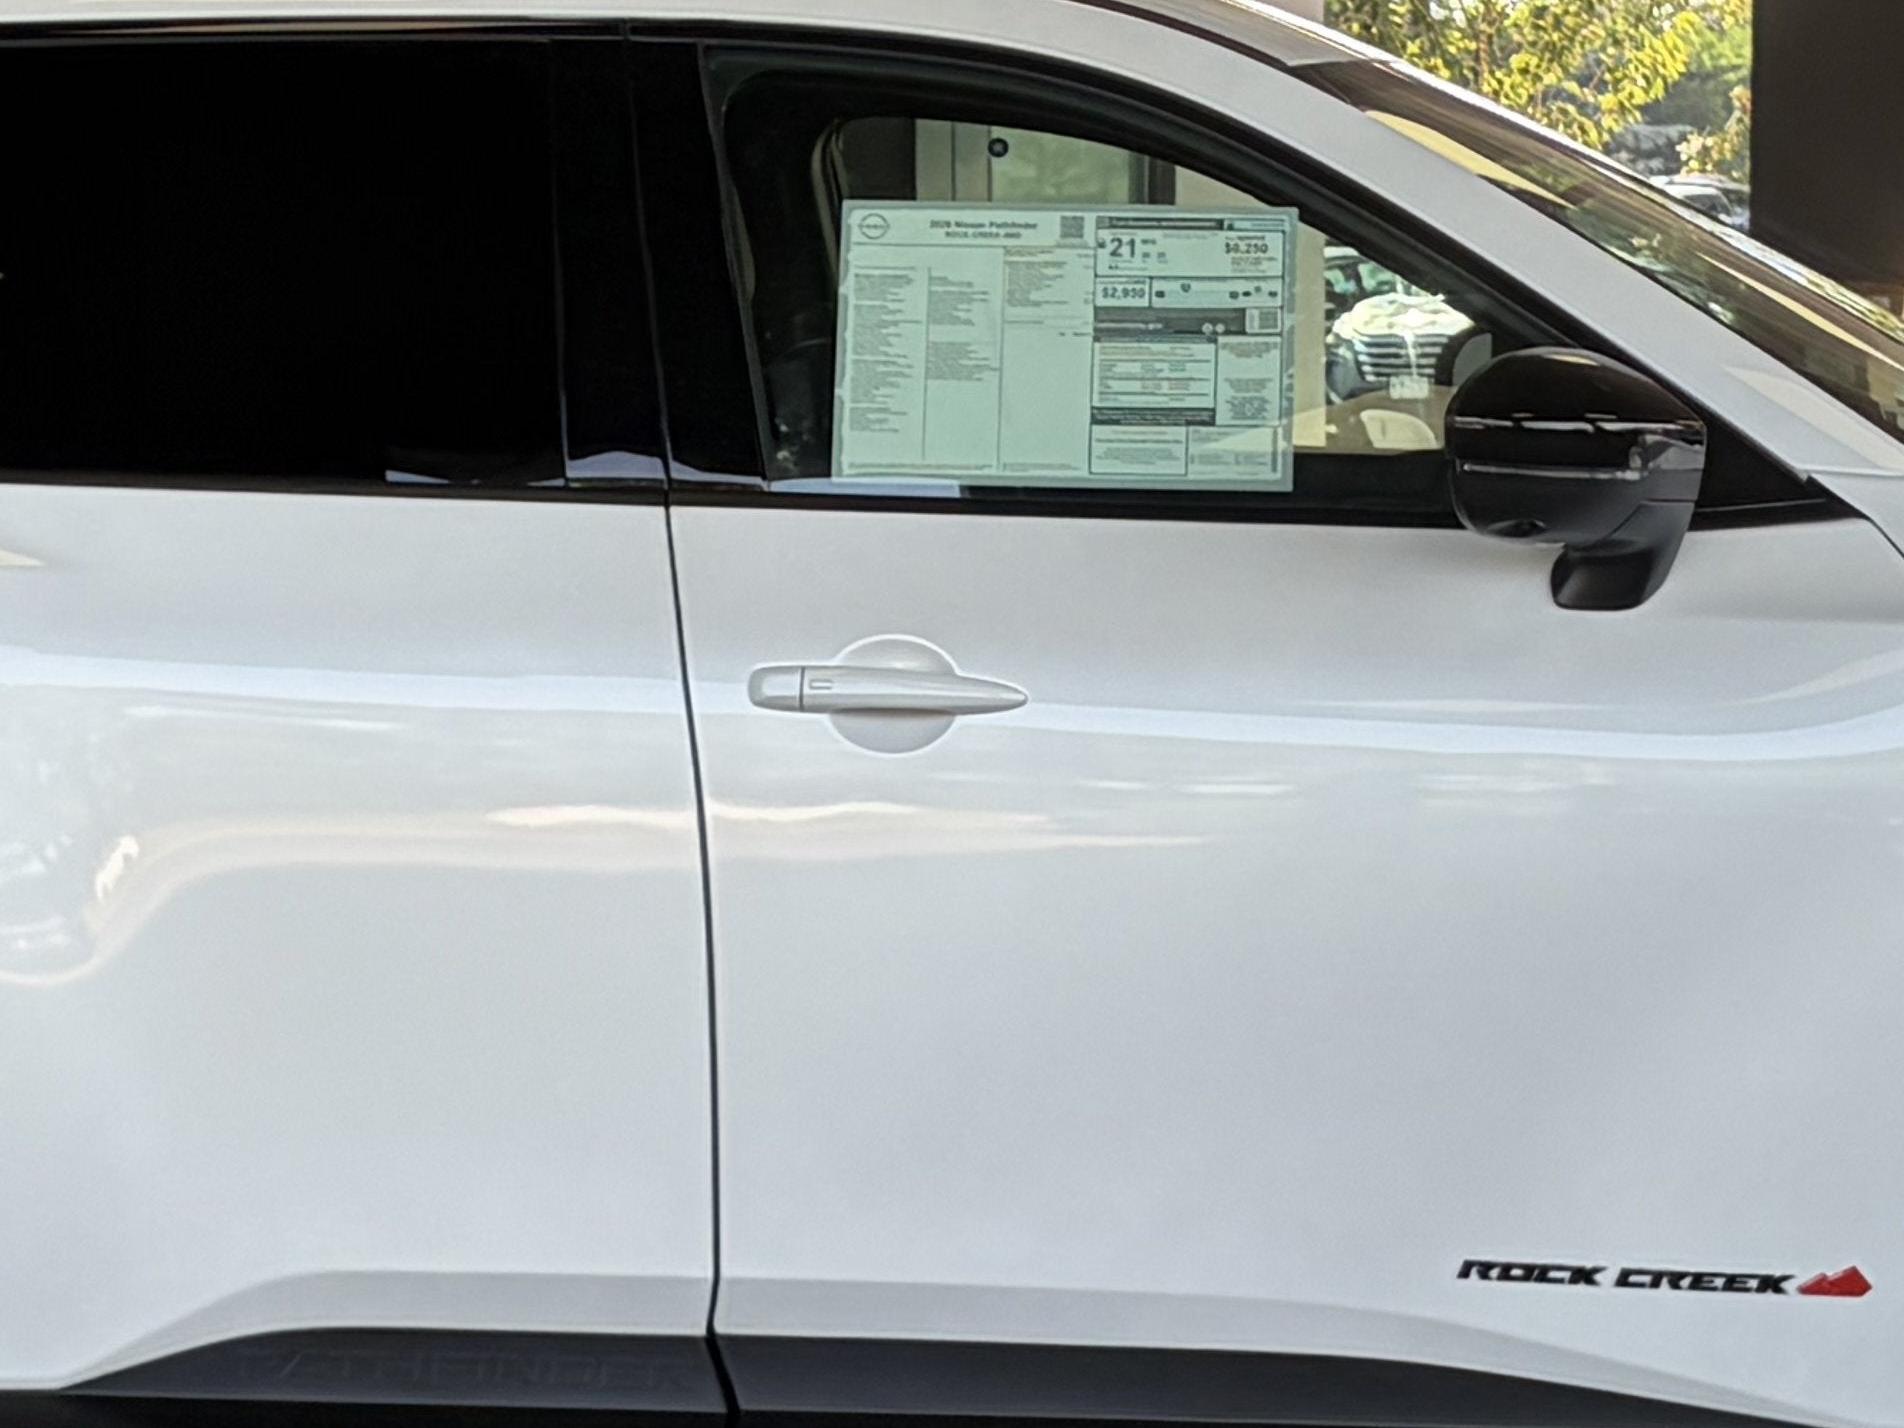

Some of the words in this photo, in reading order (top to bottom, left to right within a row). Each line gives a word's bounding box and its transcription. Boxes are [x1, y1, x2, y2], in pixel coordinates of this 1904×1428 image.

[1109, 237, 1136, 259] 21
[1456, 1259, 1607, 1286] ROCK
[1614, 1266, 1797, 1295] CREEK
